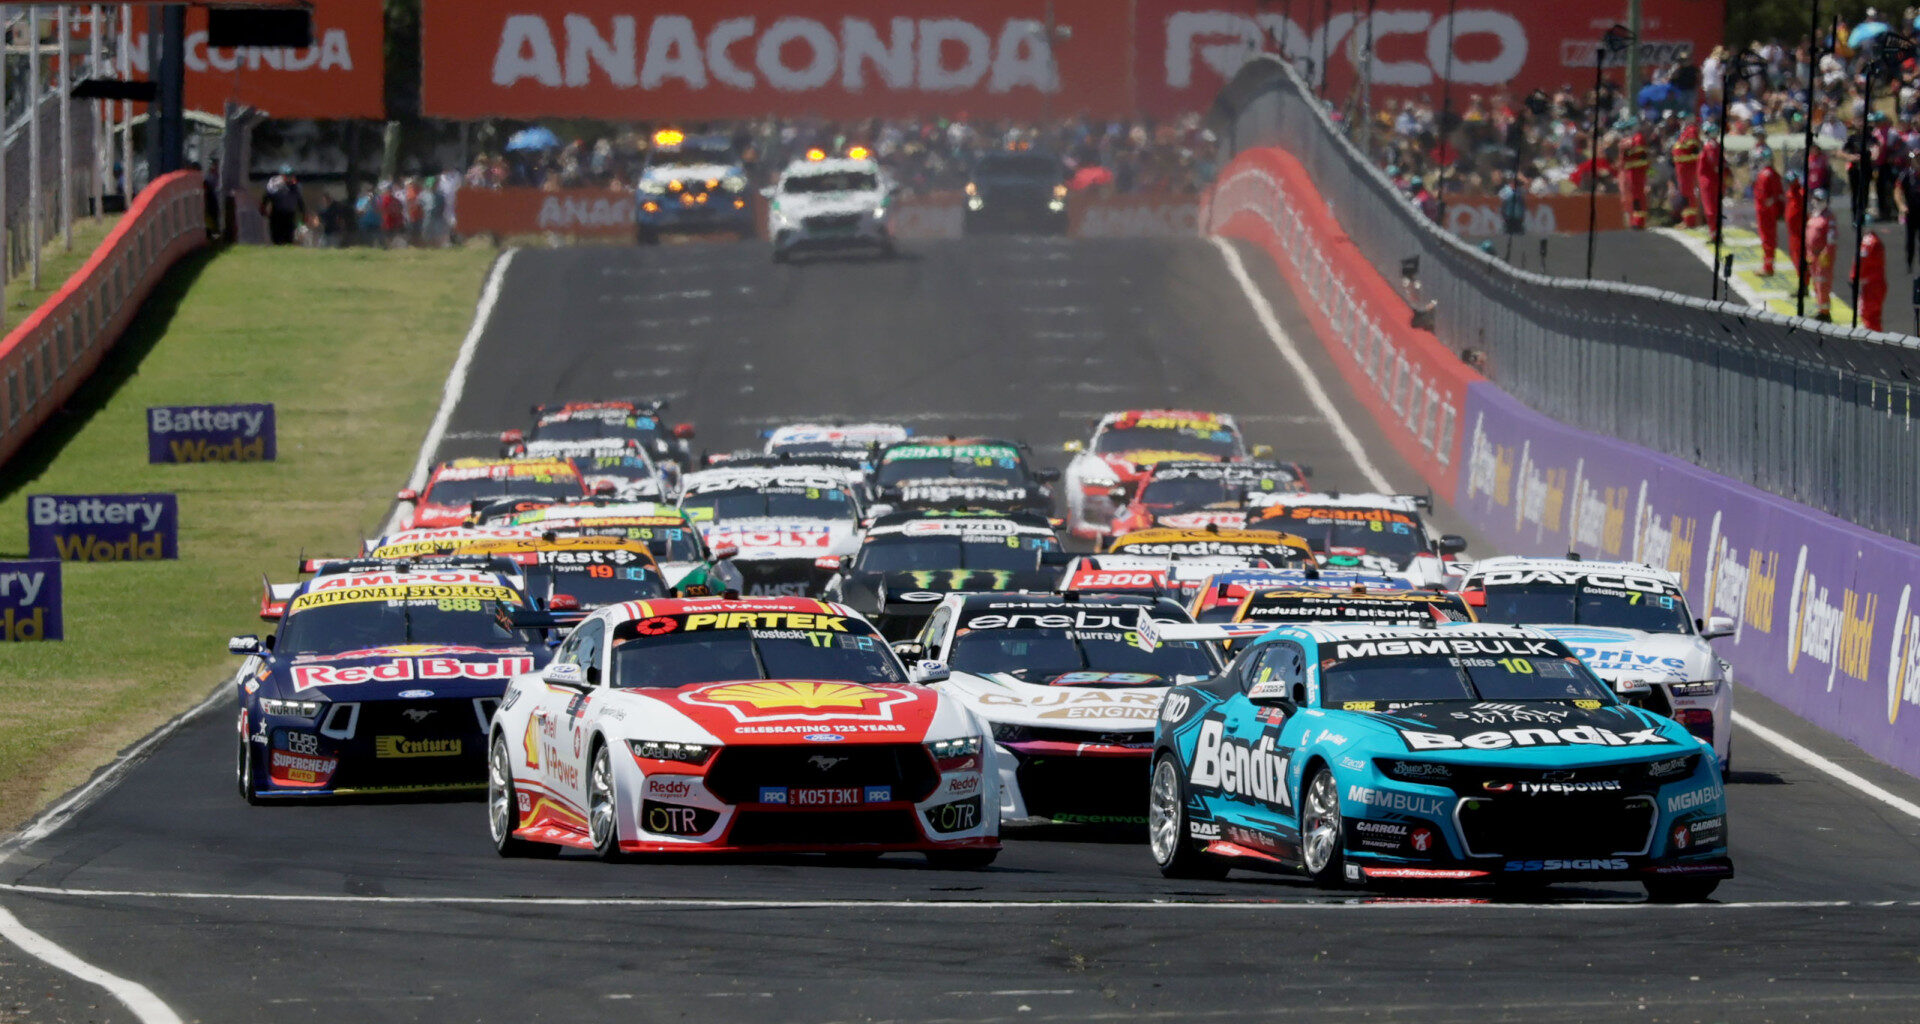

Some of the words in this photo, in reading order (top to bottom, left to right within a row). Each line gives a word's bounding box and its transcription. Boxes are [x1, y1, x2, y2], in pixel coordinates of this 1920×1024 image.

[97, 28, 353, 72] NCONDA
[492, 14, 1060, 93] ANACONDA
[1165, 10, 1529, 89] RYCO
[152, 408, 264, 436] Battery
[170, 437, 264, 462] World
[34, 497, 162, 531] Battery
[54, 533, 163, 561] World
[706, 532, 829, 547] MOLY
[586, 565, 614, 578] 19
[1077, 573, 1152, 586] 1300
[1483, 571, 1664, 594] DAYCO
[298, 585, 403, 608] NATIONAL
[406, 585, 513, 600] STORAGE
[438, 598, 482, 612] 888
[1583, 586, 1626, 598] Golding
[1626, 590, 1642, 605] 7
[682, 603, 722, 612] Shell
[725, 603, 796, 611] V-Power
[1251, 605, 1338, 616] Industrial
[1344, 607, 1430, 619] Batteries
[685, 612, 848, 632] PIRTEK
[968, 611, 1181, 630] erebu
[752, 629, 805, 640] Kostecki
[805, 632, 834, 648] 17
[1065, 630, 1122, 642] Murray
[1801, 573, 1845, 693] Battery
[1839, 587, 1878, 682] World
[1337, 639, 1559, 659] MGMBULK
[1573, 646, 1686, 669] Drive
[291, 658, 414, 692] Red
[418, 657, 535, 679] Bull
[1449, 657, 1496, 668] Bates
[1497, 657, 1535, 674] 10
[1067, 707, 1159, 719] ENGIN
[1343, 701, 1376, 711] OMP
[1450, 709, 1569, 720] SHAW
[734, 725, 831, 734] CELEBRATING
[833, 724, 857, 733] 125
[859, 724, 906, 732] YEARS
[1471, 716, 1564, 725] WINES
[394, 735, 462, 754] Century
[1401, 725, 1668, 750] Bendix
[273, 752, 337, 774] SUPERCHEAP
[544, 742, 579, 791] V-Power
[1190, 719, 1292, 807] Bendix
[290, 769, 315, 782] AUTO
[949, 776, 979, 792] Reddy
[649, 781, 690, 798] Reddy
[1520, 778, 1622, 796] Tyrepower
[1348, 785, 1445, 816] MGMBULK
[649, 807, 698, 832] OTR
[941, 803, 975, 829] OTR
[1190, 821, 1221, 835] DAF
[1356, 821, 1408, 835] CARROLL
[1361, 839, 1401, 849] TRANSPORT
